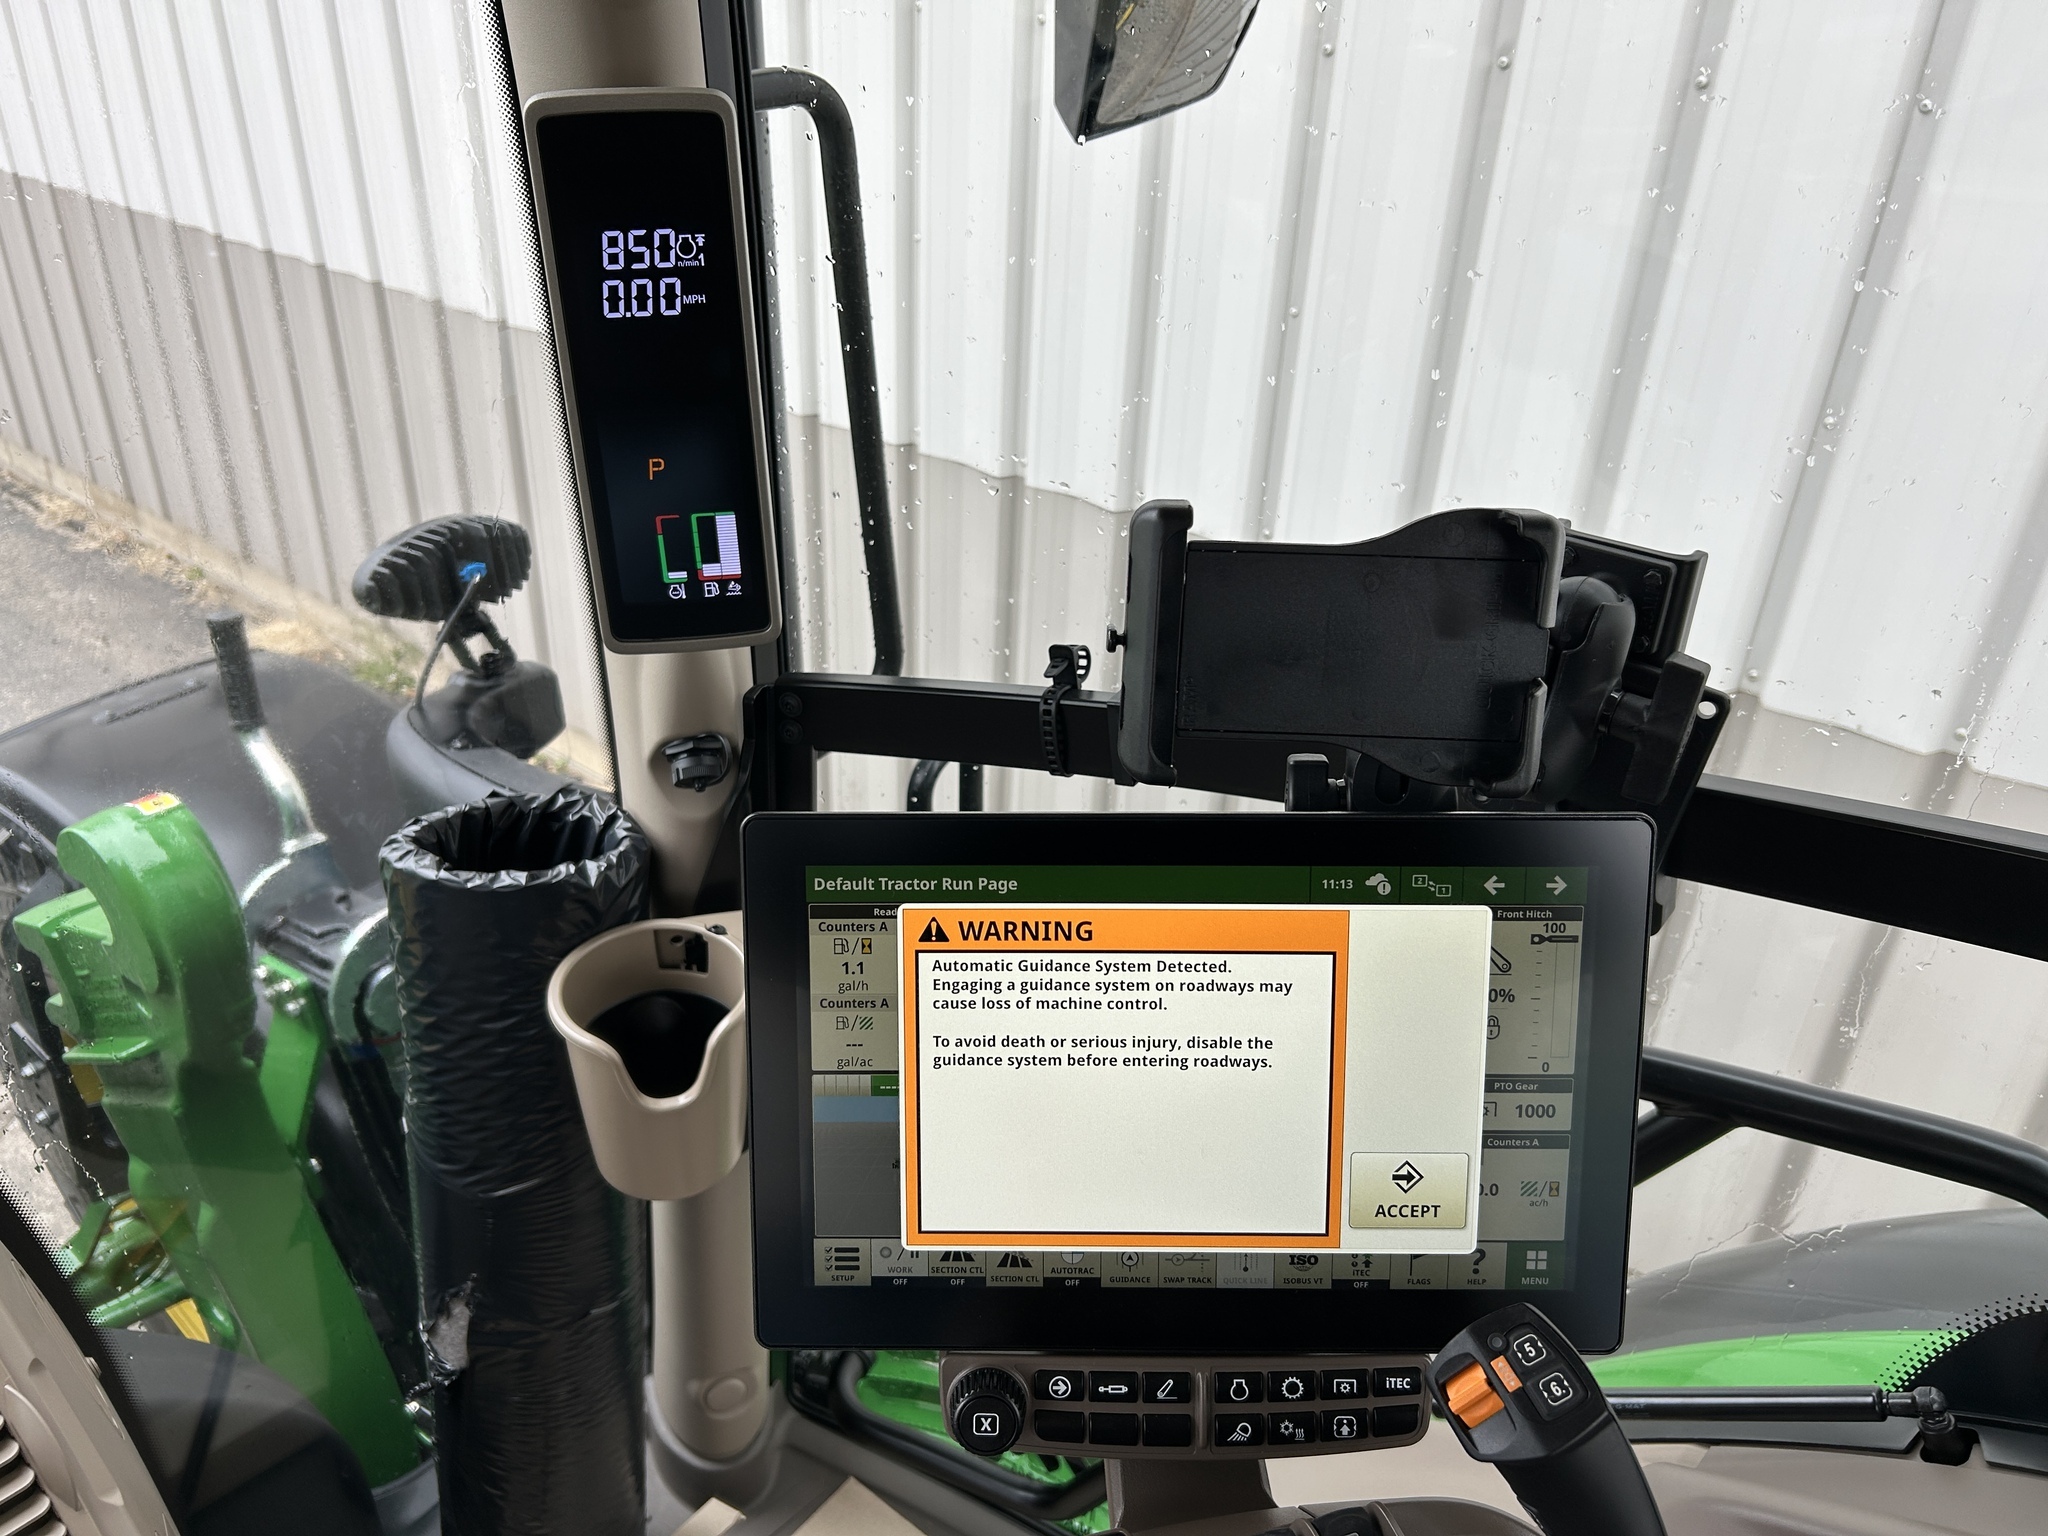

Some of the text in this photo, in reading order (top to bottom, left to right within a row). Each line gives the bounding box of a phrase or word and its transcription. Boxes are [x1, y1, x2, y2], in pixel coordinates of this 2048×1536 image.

[602, 229, 675, 270] 850
[603, 278, 705, 318] 0.00 MPH
[649, 458, 664, 480] P
[815, 877, 1017, 894] Default Tractor Run Page
[1323, 880, 1352, 889] 11:13
[1498, 910, 1552, 918] Front Hitch
[819, 922, 888, 932] Counters A
[958, 921, 1092, 941] WARNING
[1542, 922, 1567, 934] 100
[842, 962, 863, 974] 1.1
[932, 959, 1231, 975] Automatic Guidance System Detected.
[838, 981, 868, 994] gal/h
[934, 978, 1292, 996] Engaging a guidance system on roadways may
[820, 998, 889, 1008] Counters A
[933, 997, 1167, 1010] cause loss of machine control.
[933, 1035, 1273, 1052] To avoid death or serious injury, disable the
[837, 1057, 873, 1069] gal/ac
[933, 1054, 1272, 1071] guidance system before entering roadways.
[1542, 1062, 1549, 1072] 0
[1516, 1104, 1556, 1118] 1000
[1487, 1138, 1529, 1147] Counters
[1375, 1205, 1440, 1217] ACCEPT
[1288, 1254, 1319, 1266] ISO
[887, 1265, 913, 1275] WORK
[931, 1266, 984, 1275] SECTION CTL
[1524, 1342, 1536, 1357] 5
[1386, 1377, 1410, 1388] iTEC
[980, 1417, 992, 1431] X
